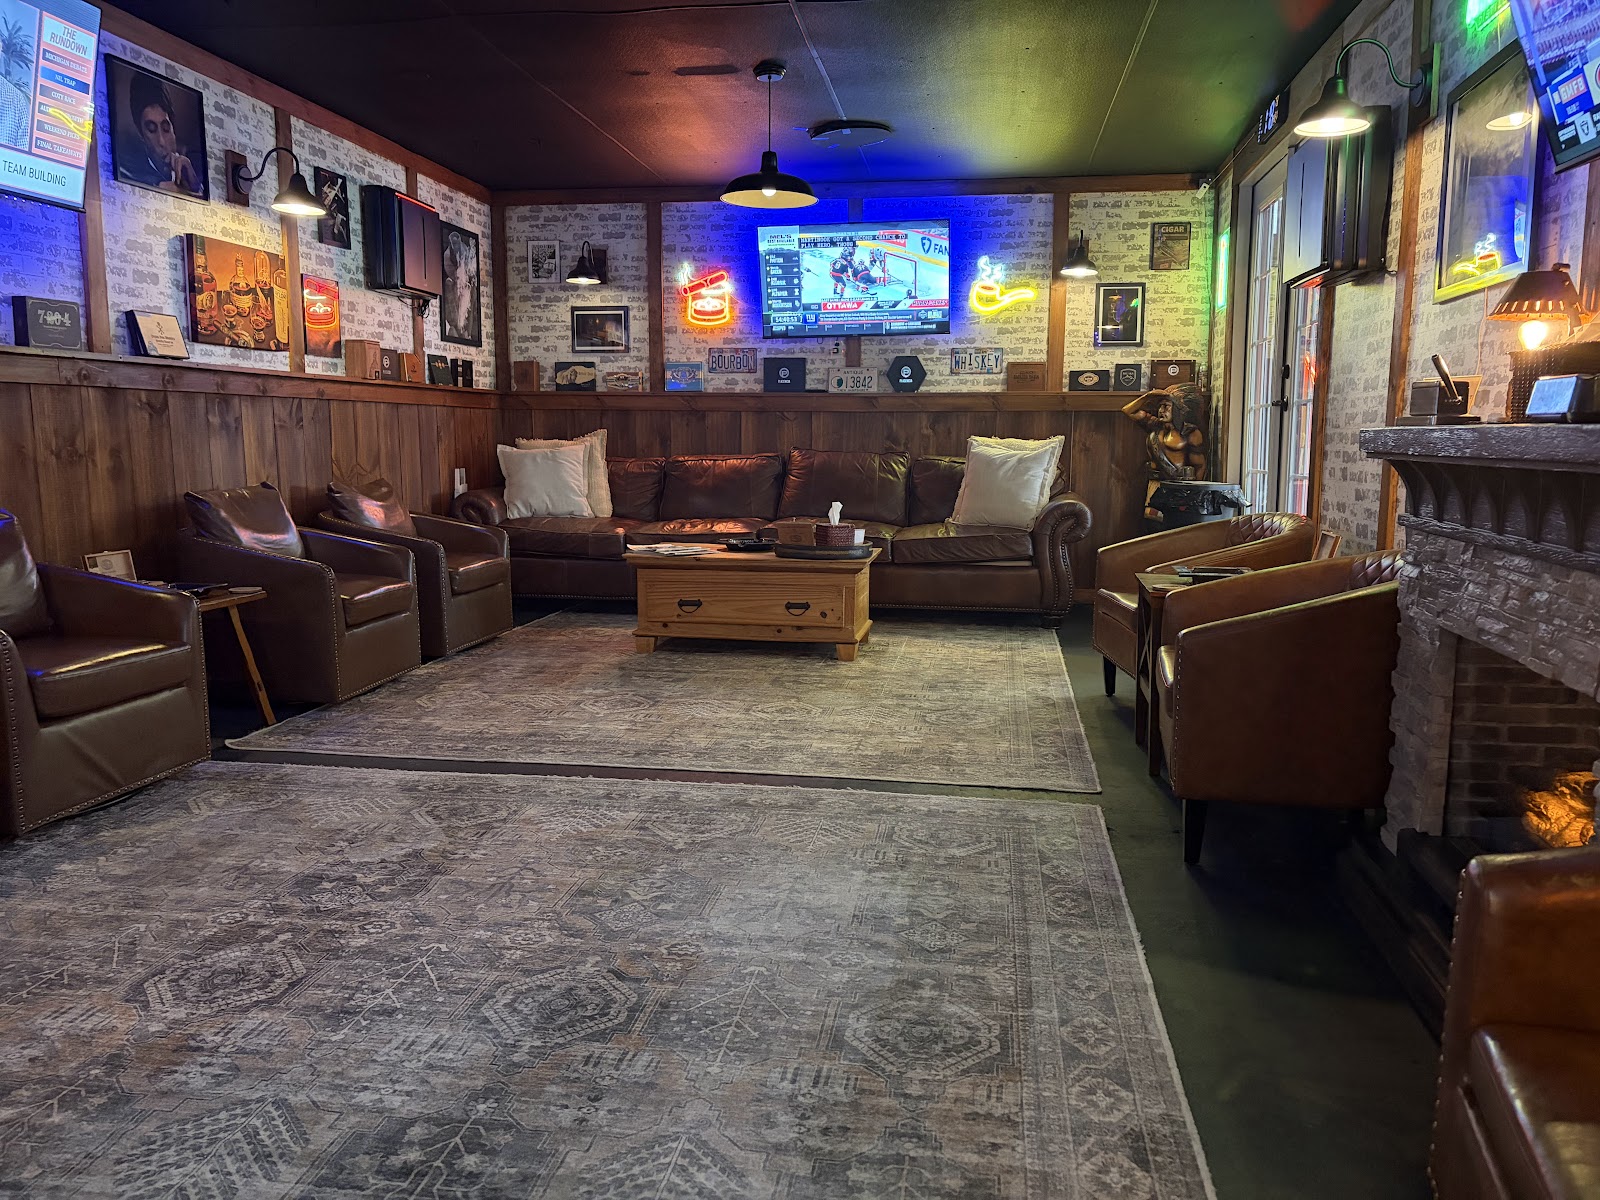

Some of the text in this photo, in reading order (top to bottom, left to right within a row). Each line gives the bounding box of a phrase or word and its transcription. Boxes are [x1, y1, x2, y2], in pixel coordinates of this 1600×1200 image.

[62, 26, 77, 41] THE
[50, 32, 88, 56] RUNDOWN
[36, 139, 83, 159] FINAL TAKEAWAYS
[3, 160, 67, 187] TEAM BUILDING
[1161, 225, 1185, 233] CIGAR
[826, 301, 858, 310] OTTAWA
[711, 354, 755, 371] BOURBON
[954, 352, 1000, 369] WHISKEY
[845, 376, 873, 389] 13842
